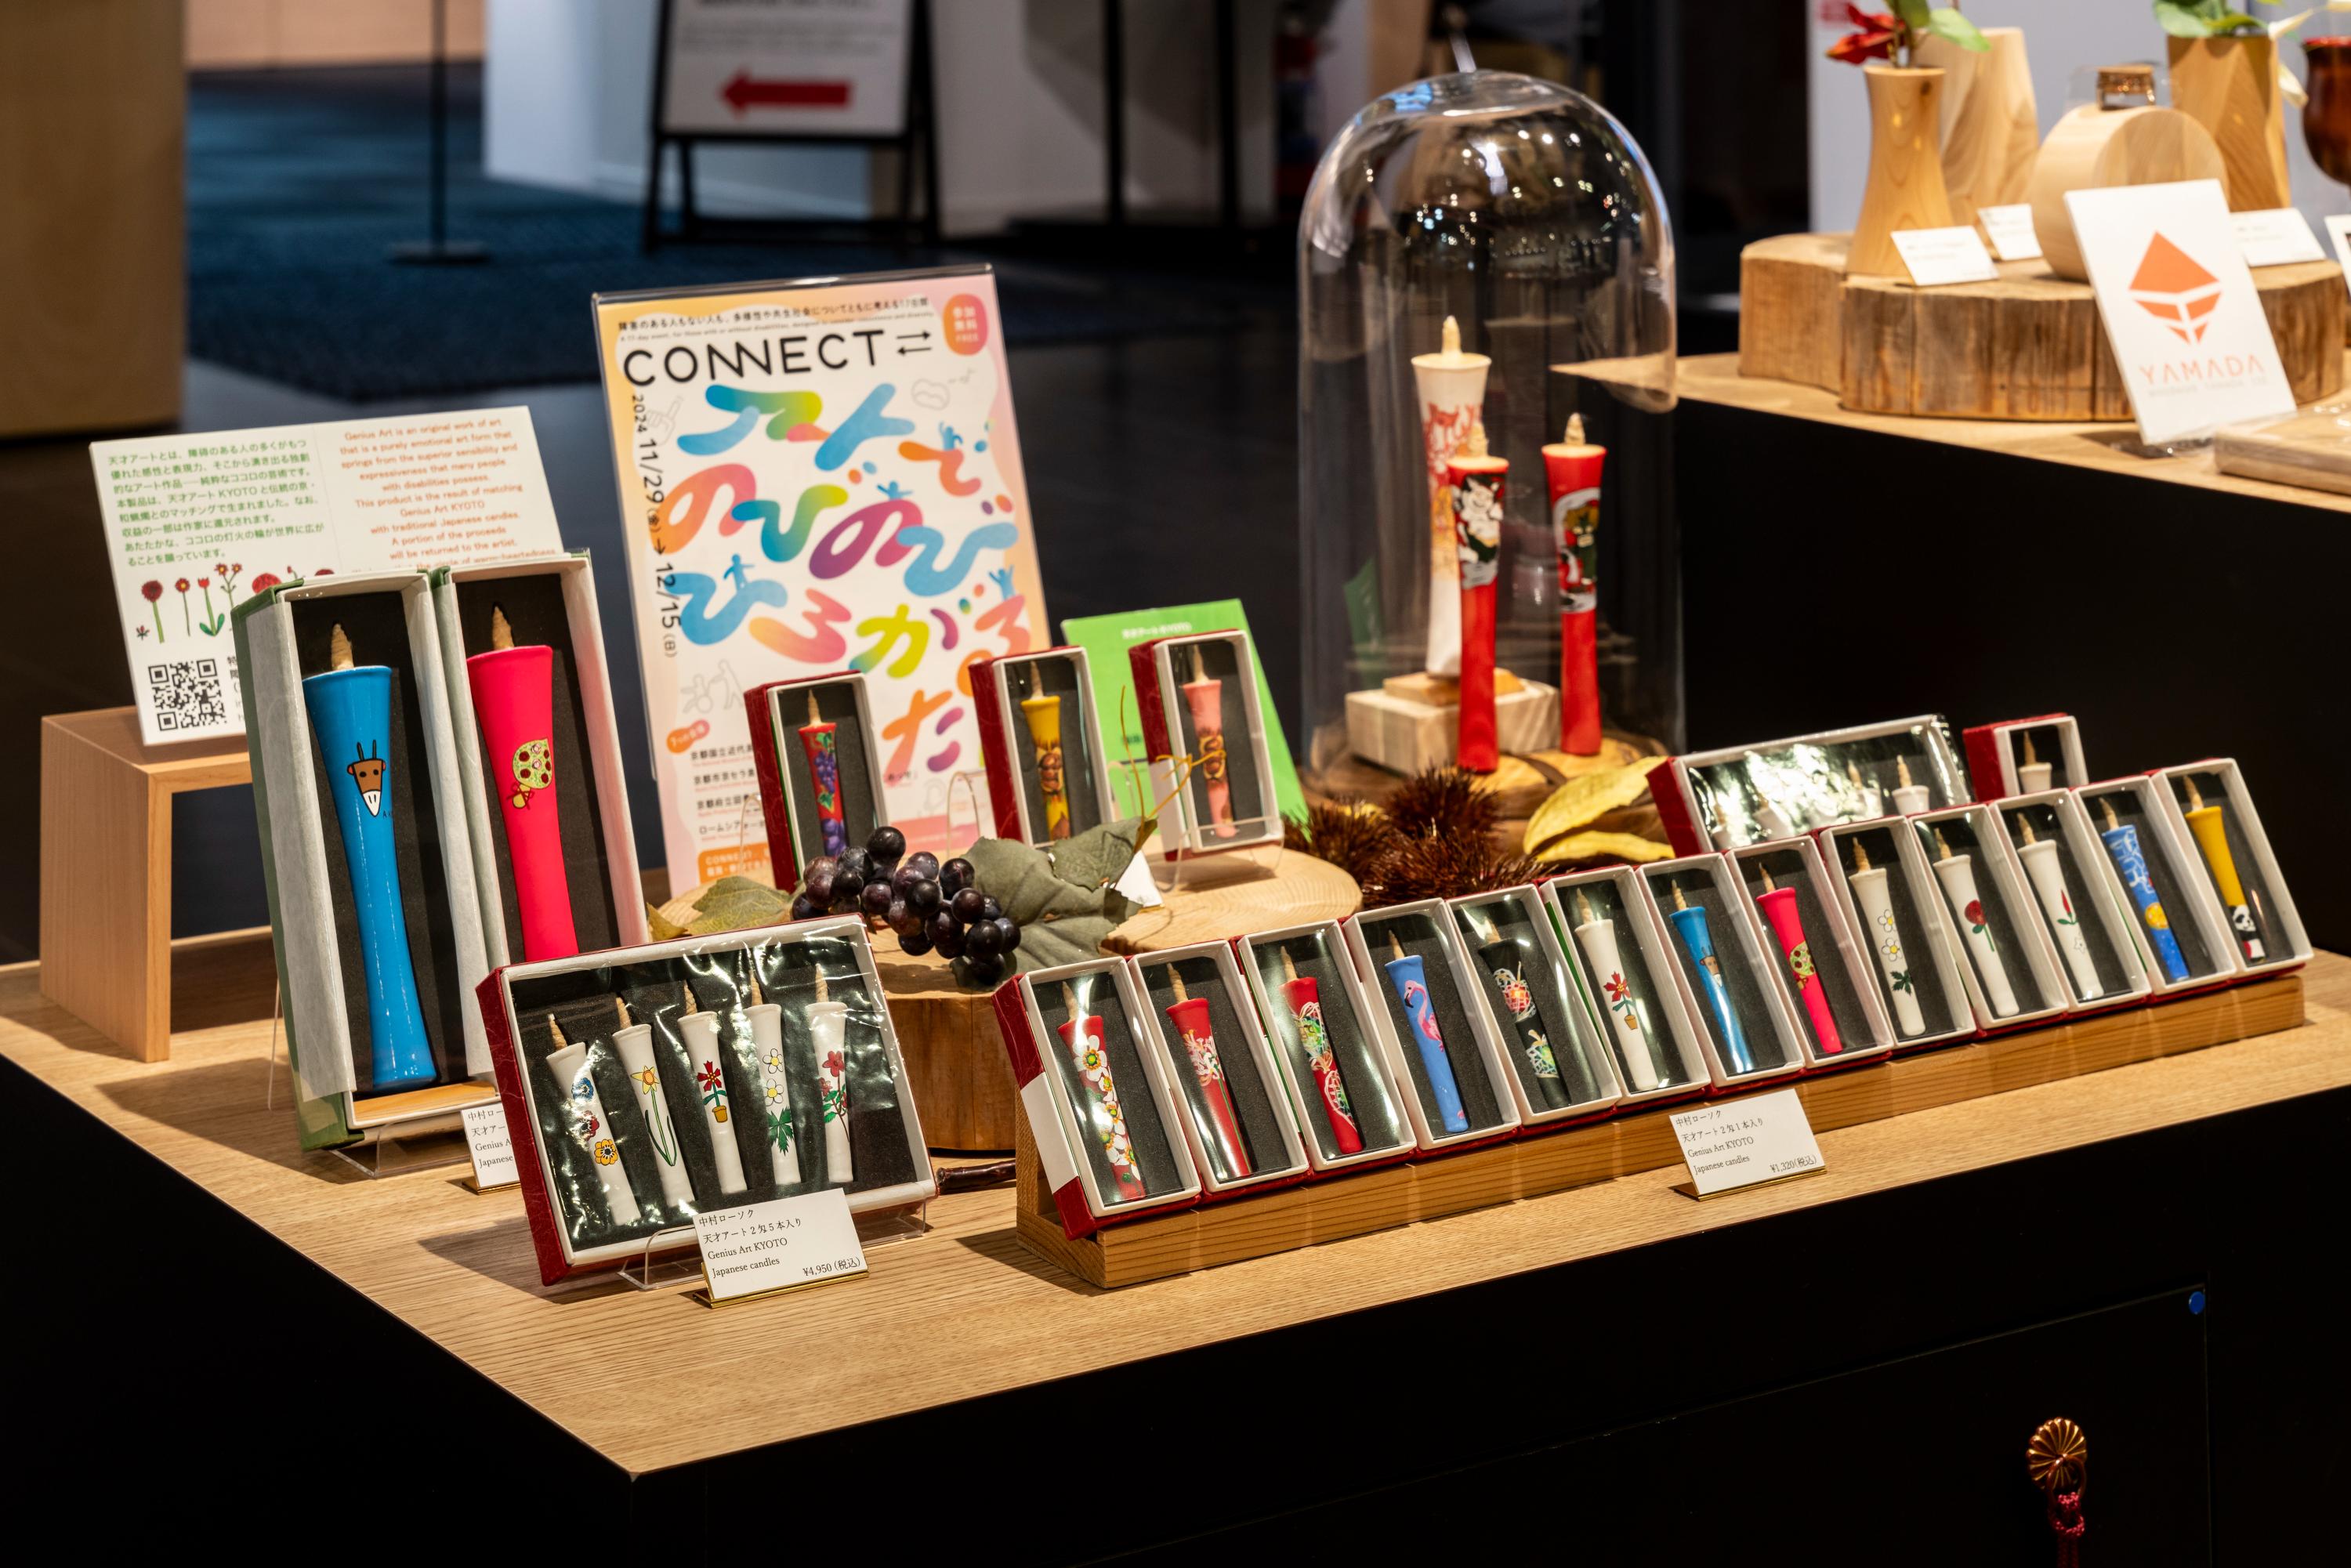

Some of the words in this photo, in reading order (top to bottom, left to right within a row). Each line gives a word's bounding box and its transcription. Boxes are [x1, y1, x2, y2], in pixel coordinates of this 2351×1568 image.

[623, 329, 885, 386] CONNECT
[2139, 354, 2266, 386] YAMADA
[632, 394, 647, 433] 2024
[345, 432, 376, 441] Genius
[379, 429, 393, 438] Art
[420, 423, 451, 434] original
[380, 442, 408, 452] purely
[411, 436, 453, 448] emotional
[342, 459, 374, 469] springs
[418, 451, 452, 462] superior
[456, 445, 499, 457] sensibility
[359, 467, 427, 480] expressiveness
[477, 458, 506, 469] people
[219, 486, 258, 498] KYOTO
[404, 478, 451, 490] disabilities
[378, 495, 412, 508] product
[443, 488, 469, 499] result
[483, 484, 523, 495] matching
[400, 508, 431, 518] Genius
[434, 505, 448, 514] Art
[451, 500, 485, 512] KYOTO
[392, 520, 437, 532] traditional
[440, 516, 483, 527] Japanese
[401, 535, 434, 546] portion
[465, 527, 507, 539] proceeds
[421, 545, 460, 557] returned
[1675, 1110, 1722, 1126] 中村ローソク
[475, 1140, 503, 1151] Genius
[1687, 1147, 1712, 1158] Genius
[1714, 1143, 1725, 1153] Art
[1726, 1136, 1754, 1150] KYOTO
[479, 1155, 514, 1168] Japanese
[1694, 1162, 1724, 1175] Japanese
[1725, 1154, 1750, 1167] candles
[699, 1209, 754, 1227] 中村ローソク
[708, 1248, 737, 1260] Genius
[739, 1244, 752, 1255] Art
[754, 1237, 788, 1251] KYOTO
[712, 1265, 748, 1279] Japanese
[749, 1257, 780, 1269] candles
